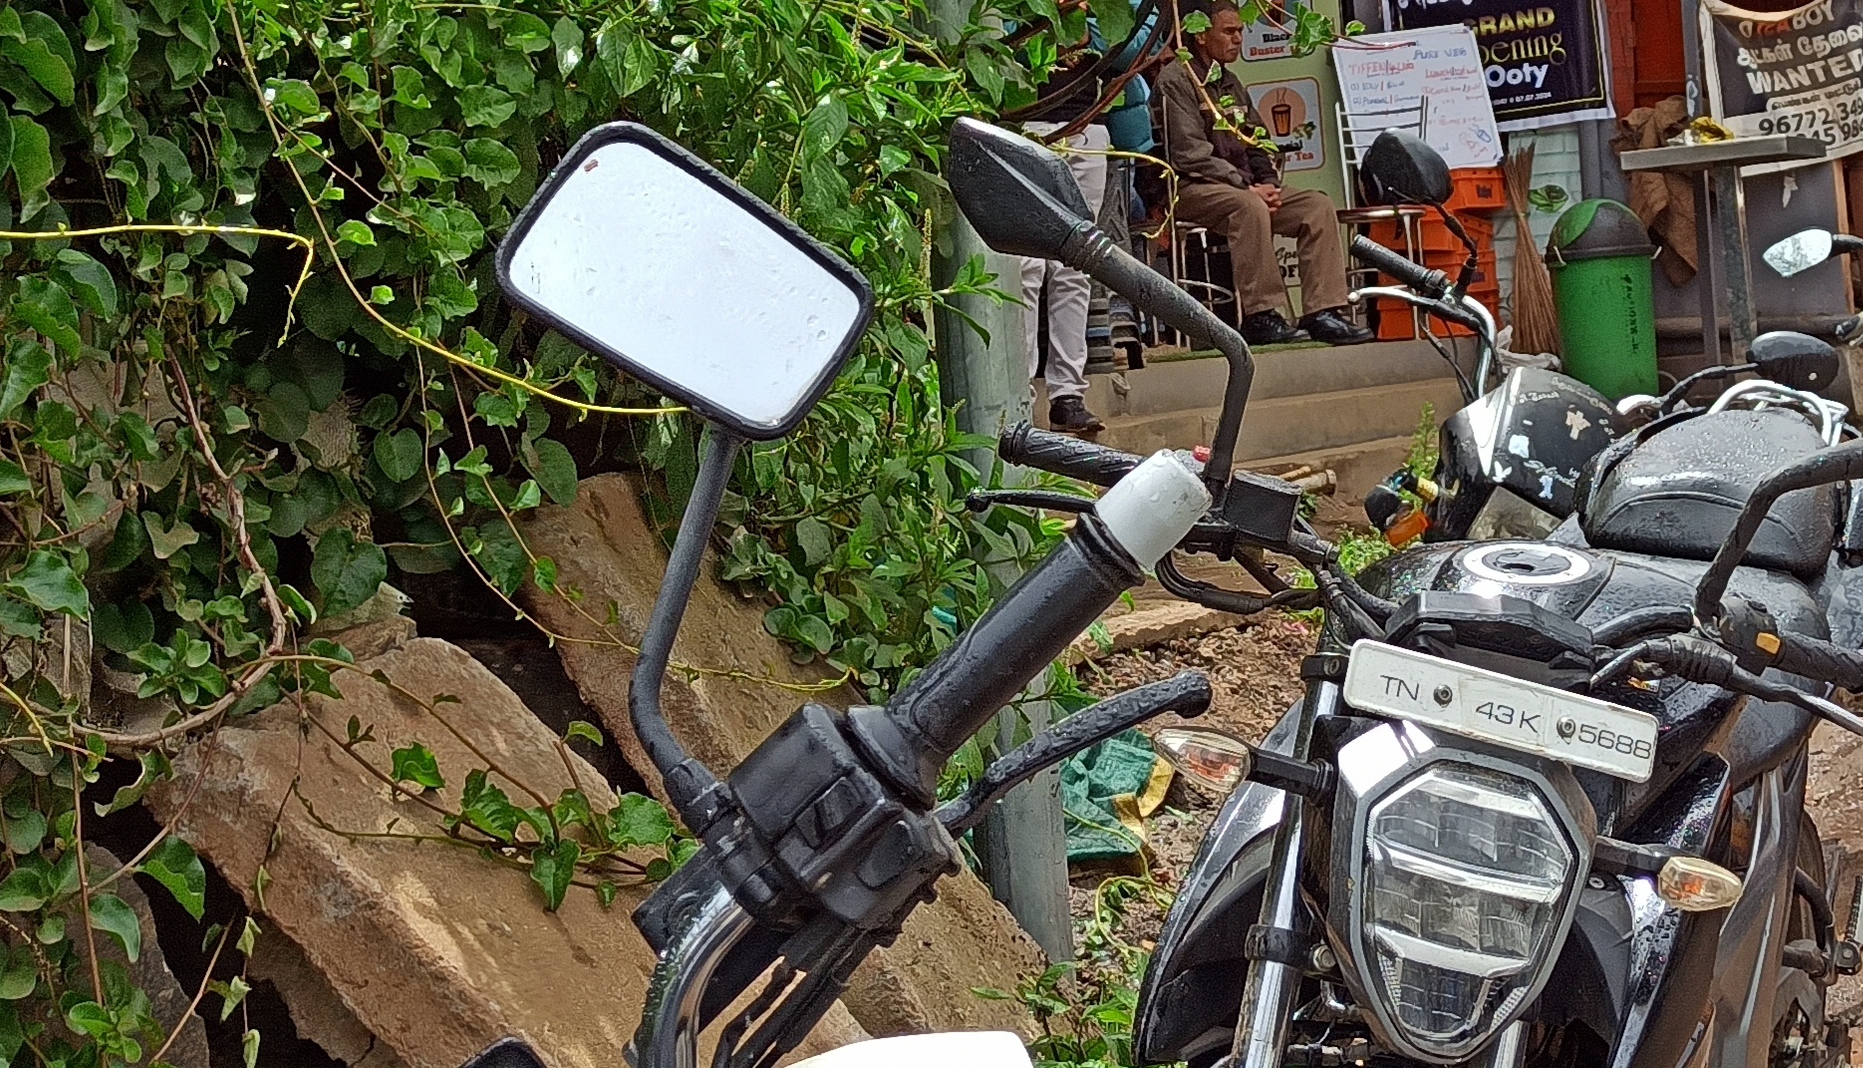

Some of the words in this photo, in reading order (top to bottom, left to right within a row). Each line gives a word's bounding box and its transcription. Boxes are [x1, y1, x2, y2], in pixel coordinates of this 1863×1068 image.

[1484, 63, 1549, 89] Ooty
[1758, 107, 1836, 135] 96772
[1295, 151, 1314, 161] Tea
[1379, 674, 1421, 702] TN
[1578, 723, 1652, 761] 5688
